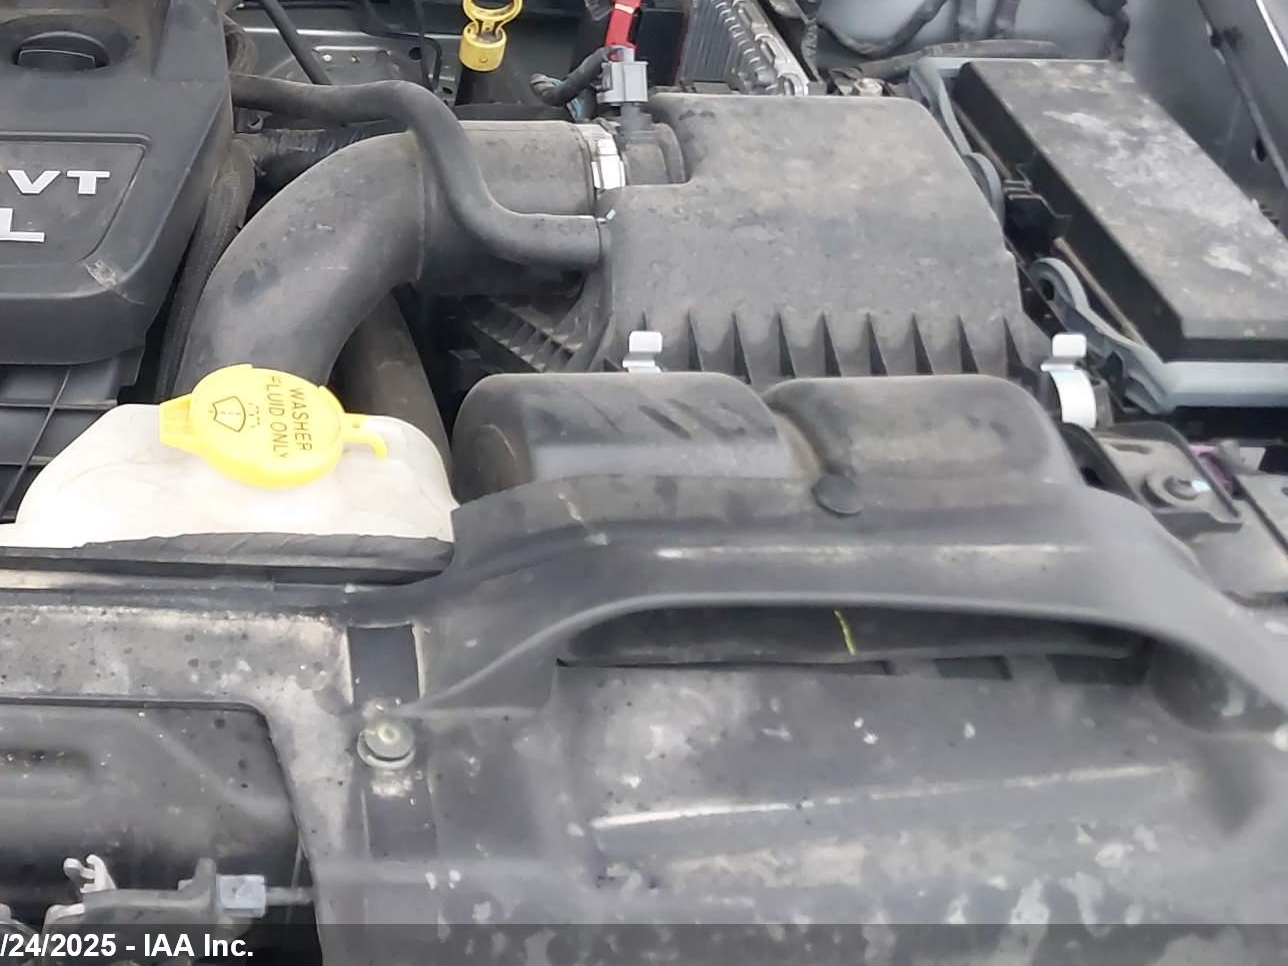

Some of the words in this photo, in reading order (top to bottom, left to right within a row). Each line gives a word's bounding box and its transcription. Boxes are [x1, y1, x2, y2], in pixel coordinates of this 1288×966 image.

[266, 376, 285, 416] FLUID
[290, 388, 313, 451] WASHER
[270, 422, 288, 458] ONLY
